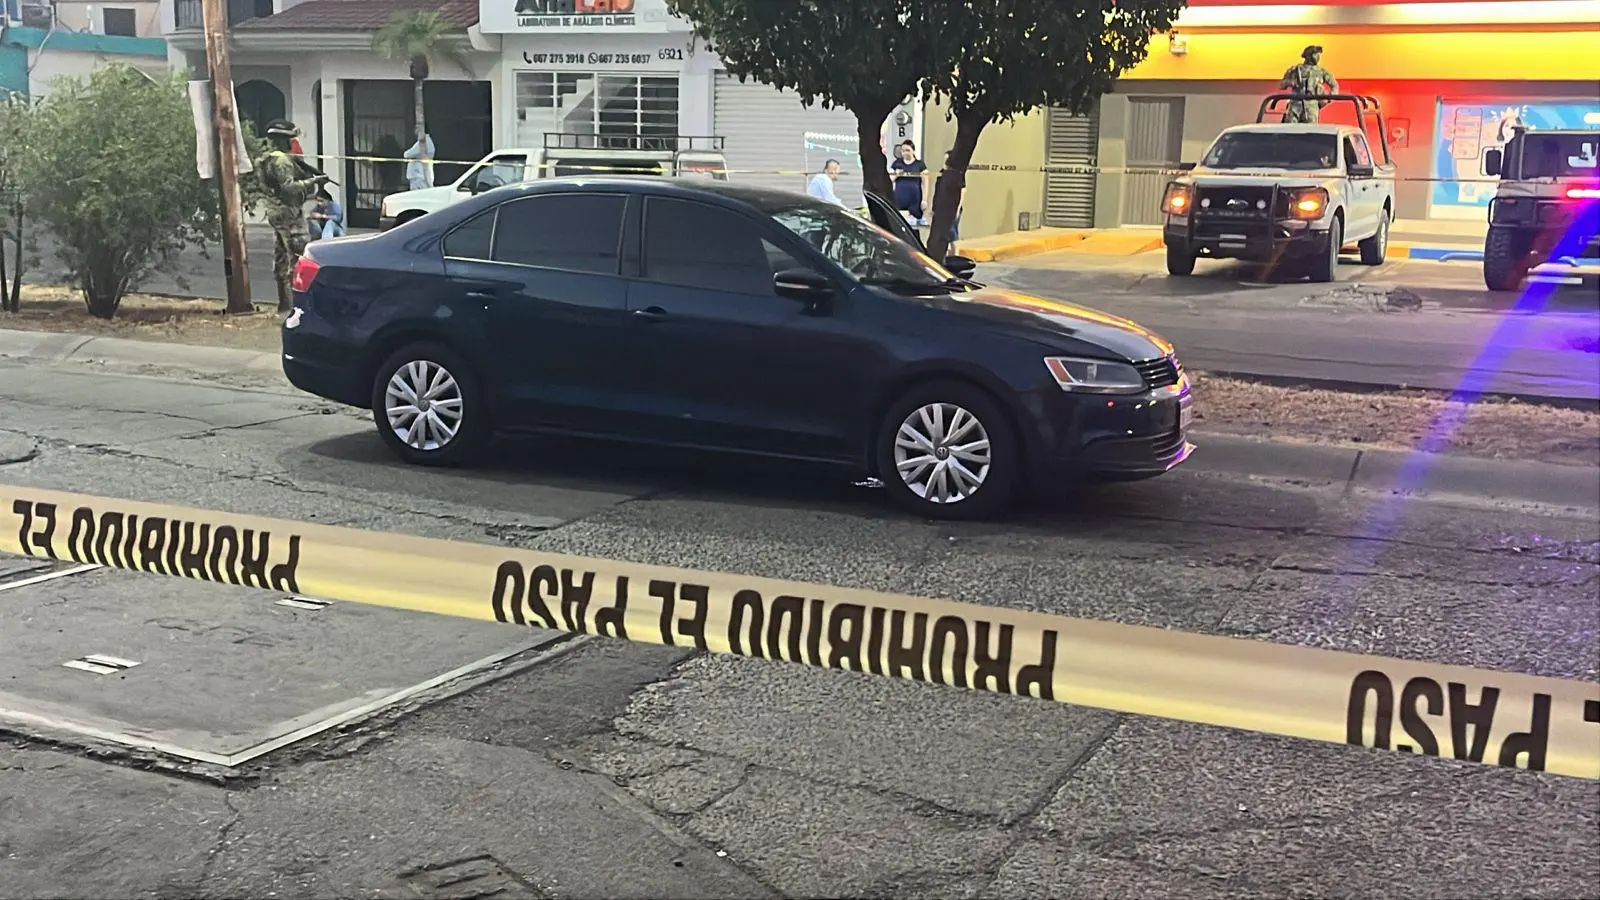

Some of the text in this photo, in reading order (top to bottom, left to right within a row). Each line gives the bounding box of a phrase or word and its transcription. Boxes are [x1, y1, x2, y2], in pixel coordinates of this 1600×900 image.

[562, 17, 571, 26] DE
[533, 53, 547, 64] 667
[549, 53, 563, 64] 275
[599, 53, 612, 64] 667
[658, 48, 684, 60] 6921
[898, 126, 906, 137] B
[13, 500, 301, 594] PROHIBIDO EL
[492, 560, 1058, 701] PROHIBIDO EL PASO
[1346, 670, 1552, 772] PASO
